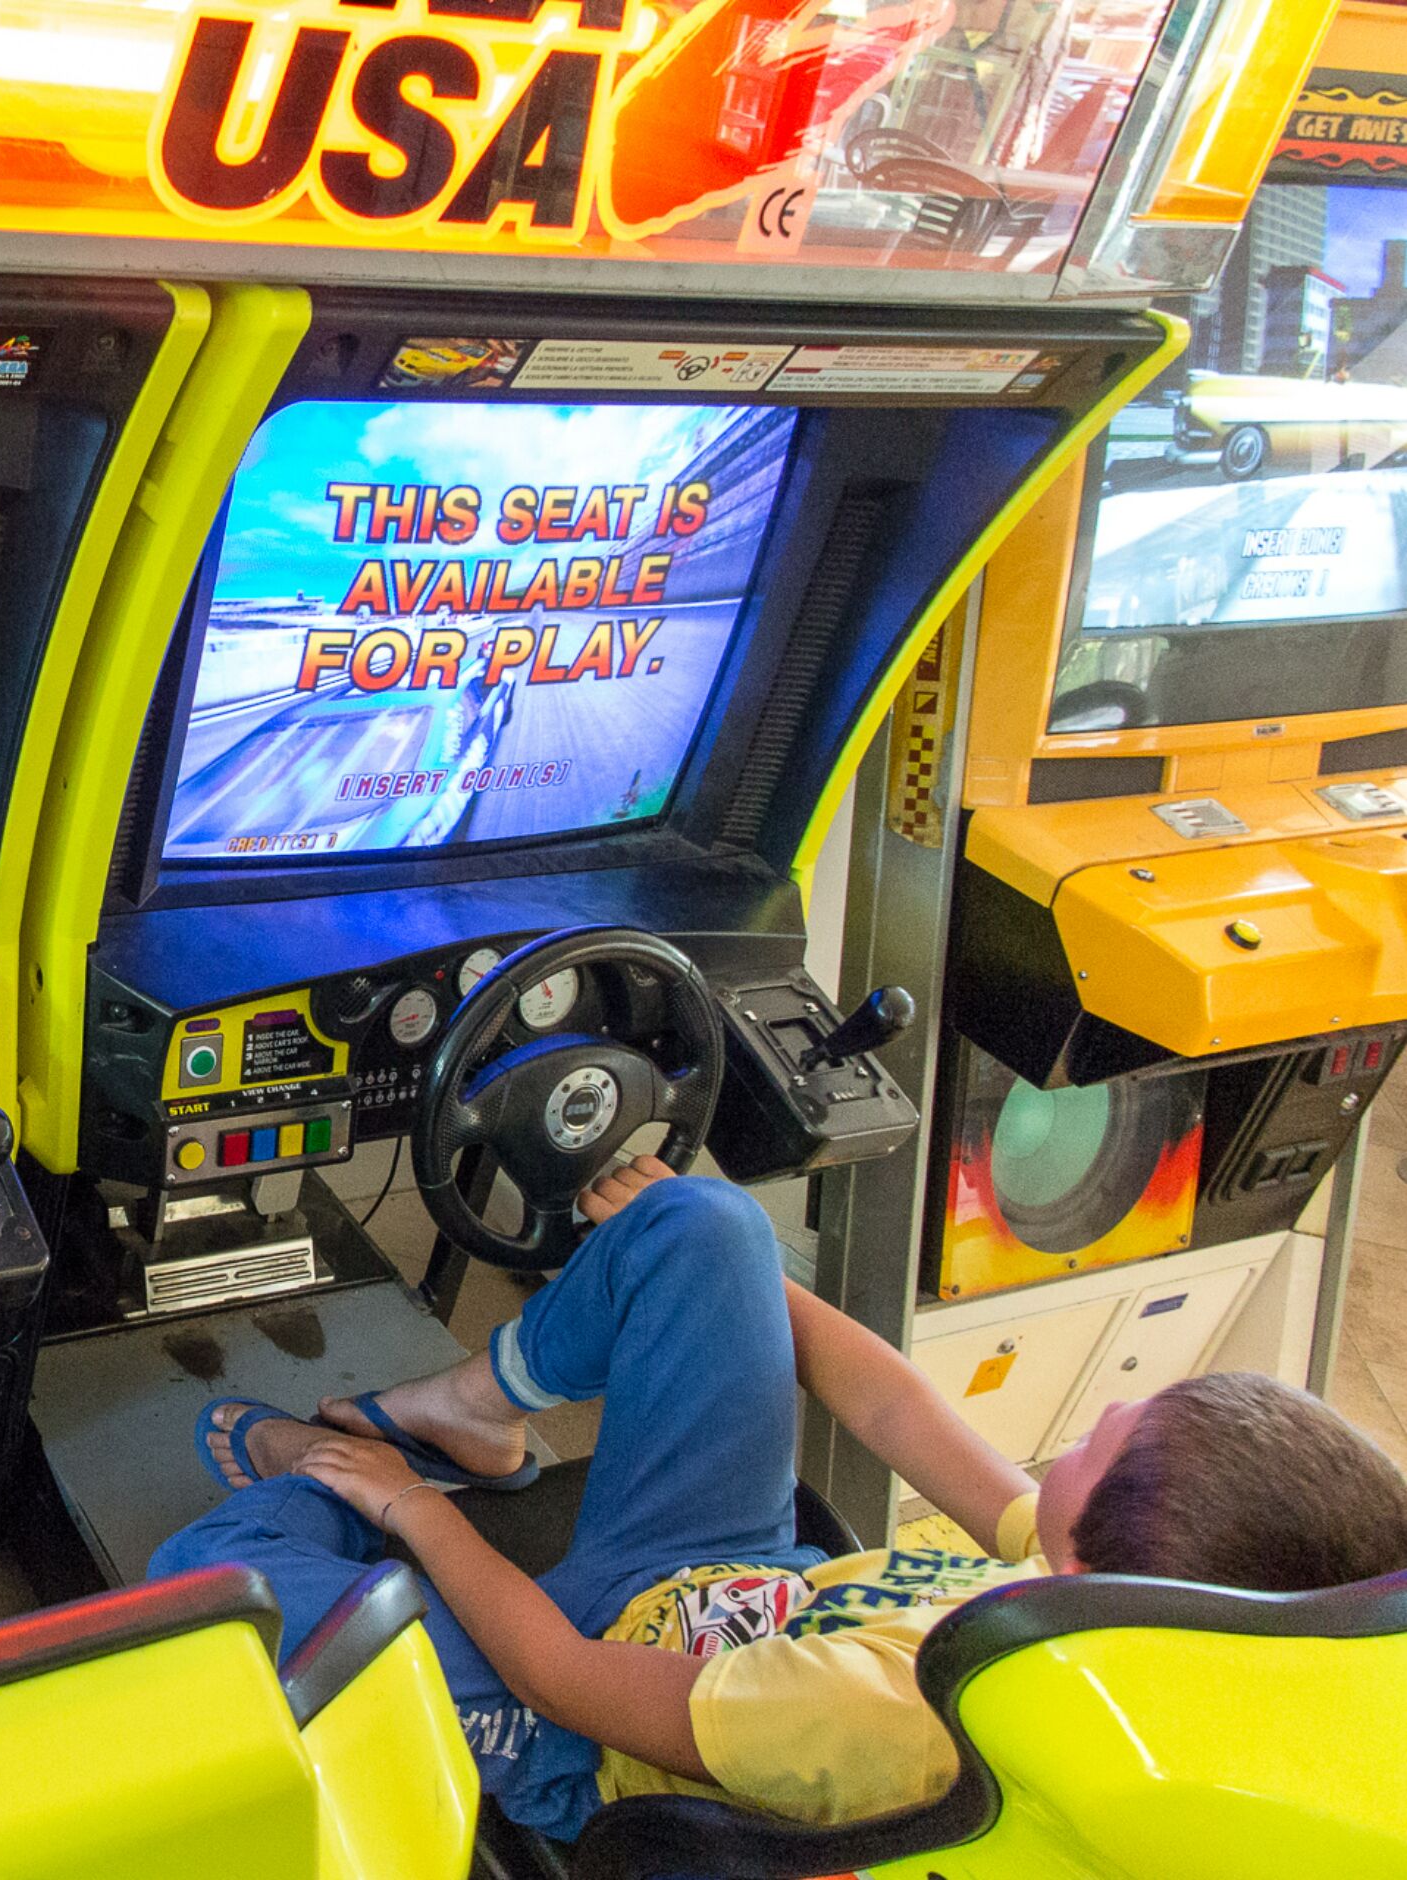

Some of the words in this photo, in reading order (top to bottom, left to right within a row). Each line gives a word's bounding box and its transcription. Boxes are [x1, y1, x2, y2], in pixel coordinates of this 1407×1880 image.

[161, 17, 601, 228] USA
[1296, 115, 1343, 139] GET
[326, 482, 481, 544] THIS
[497, 484, 648, 544] SEAT
[654, 481, 712, 537] IS
[1241, 528, 1294, 558] INSERT
[335, 553, 672, 616] AVAILABLE
[293, 627, 467, 693] FOR
[485, 616, 666, 686] PLAY.
[334, 770, 448, 802] INSERT
[246, 1053, 253, 1061] 3
[255, 1051, 273, 1059] ABOVE
[255, 1042, 273, 1050] ABOVE
[253, 1066, 272, 1074] ABOVE
[794, 1075, 808, 1087] 2
[230, 1100, 236, 1108] 1
[310, 1088, 318, 1096] 4
[242, 1088, 264, 1097] VIEW
[266, 1083, 302, 1094] CHANGE
[169, 1102, 210, 1117] START
